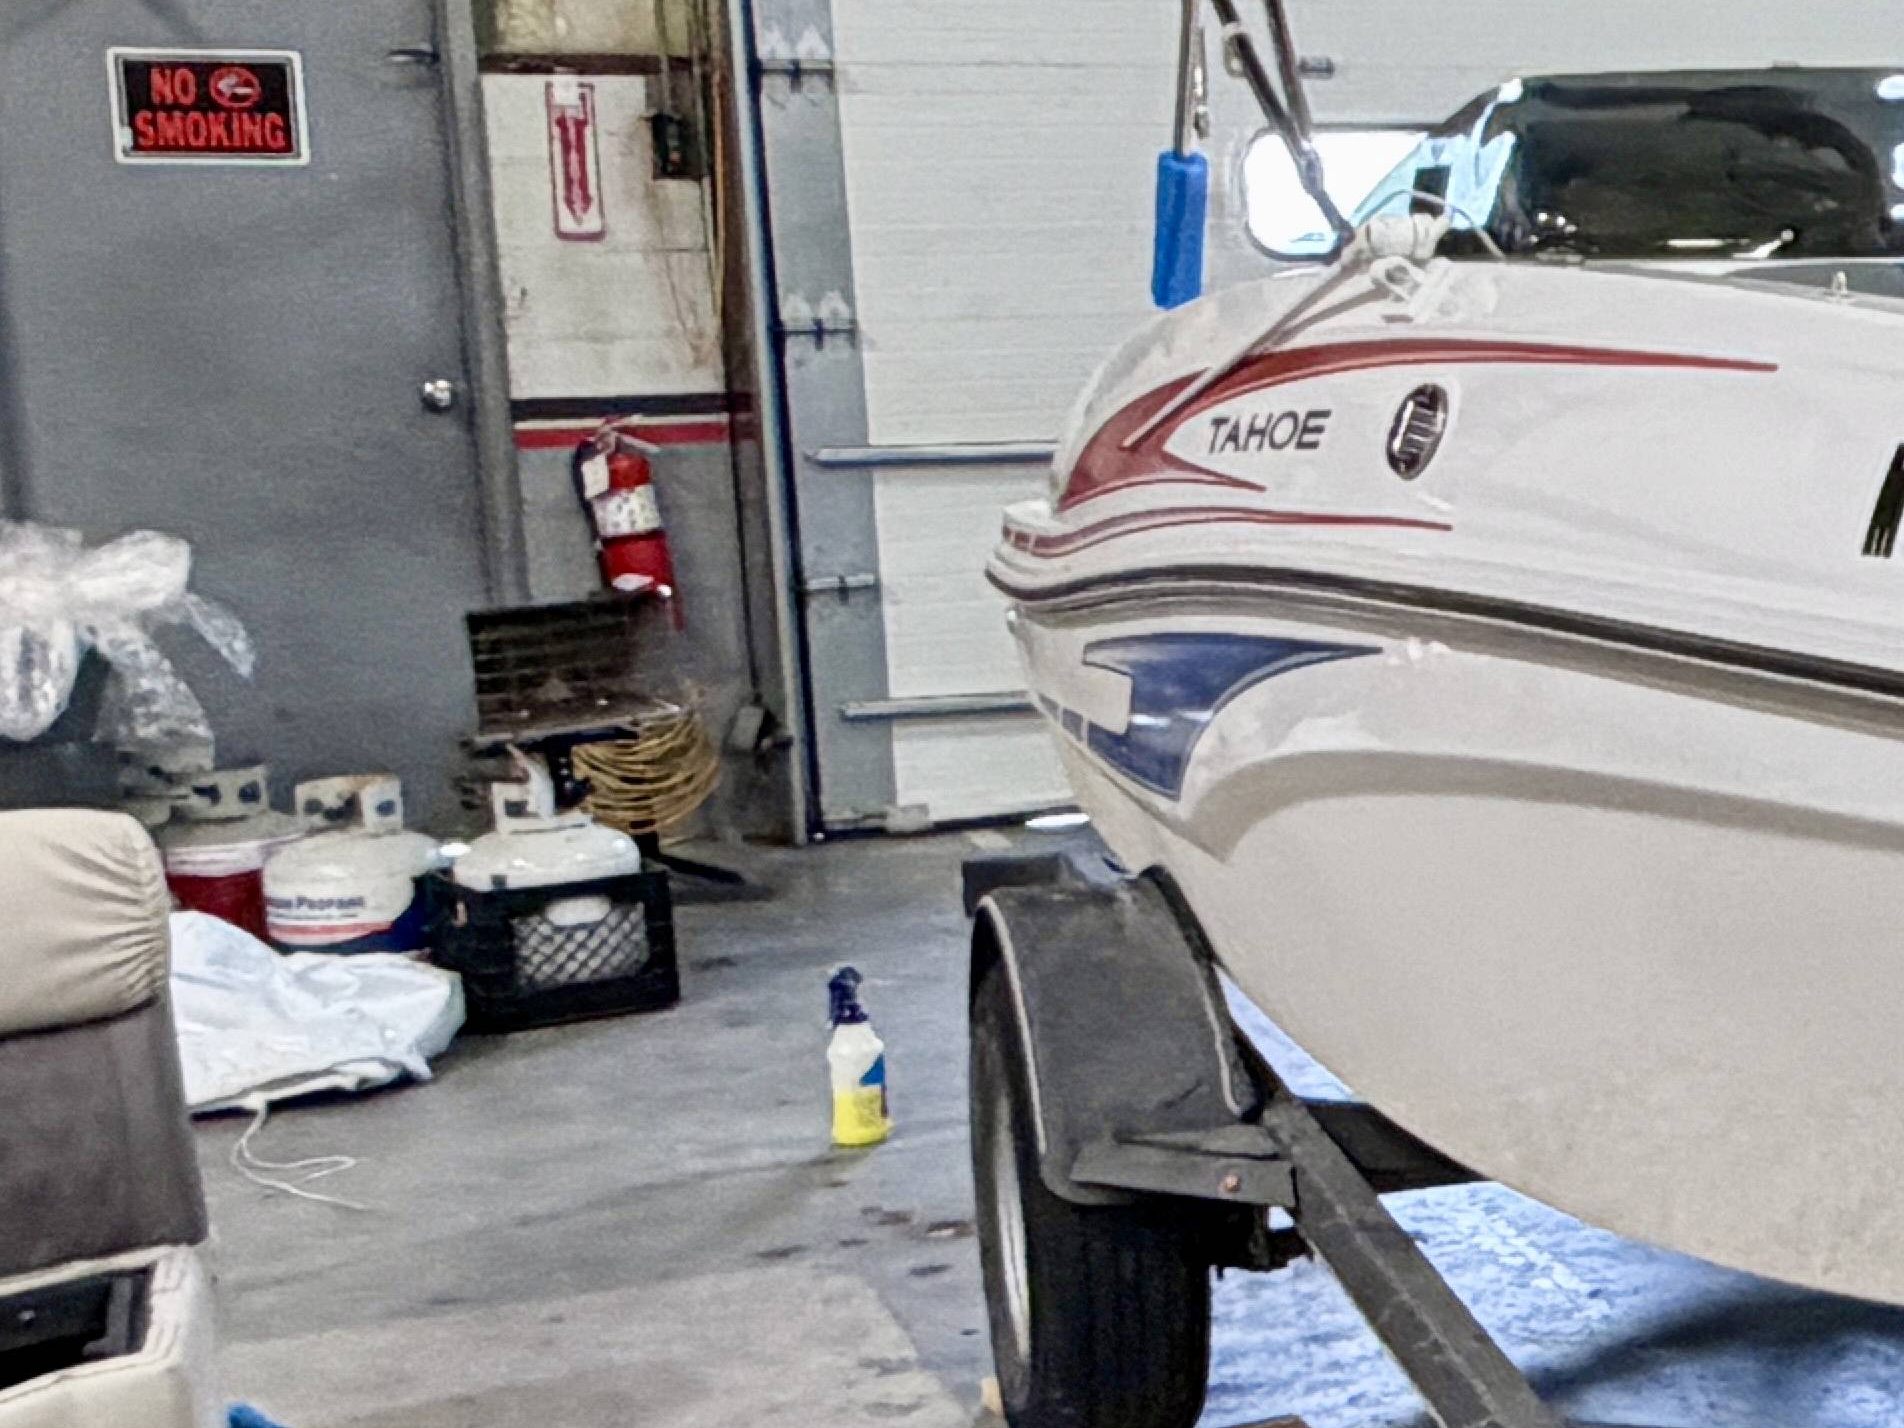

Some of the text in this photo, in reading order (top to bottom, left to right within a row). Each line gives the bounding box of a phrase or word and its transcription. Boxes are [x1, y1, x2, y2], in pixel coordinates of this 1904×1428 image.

[150, 66, 196, 106] NO
[134, 109, 286, 149] SMOKING
[1208, 409, 1332, 454] TAHOE
